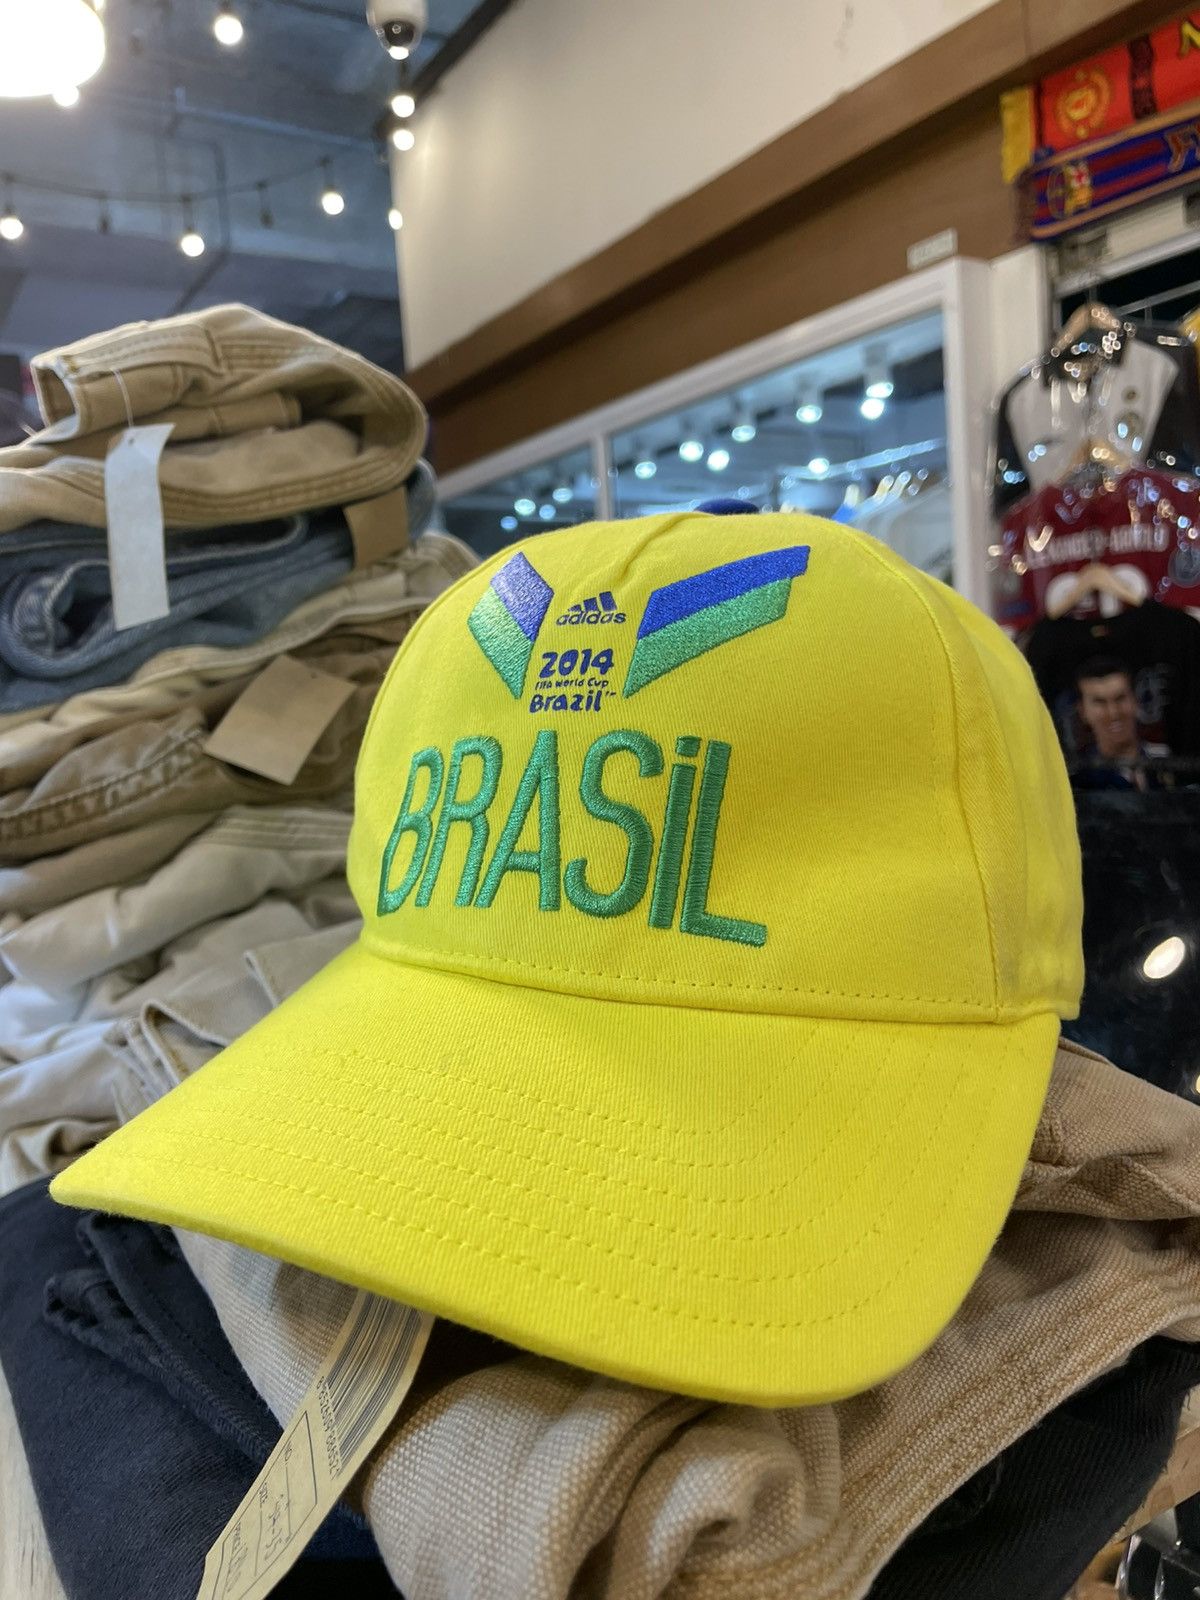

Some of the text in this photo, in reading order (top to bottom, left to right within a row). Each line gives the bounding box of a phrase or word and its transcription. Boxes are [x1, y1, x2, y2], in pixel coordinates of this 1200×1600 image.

[556, 610, 627, 626] adidas
[539, 648, 615, 679] 2014
[586, 676, 609, 689] Cup
